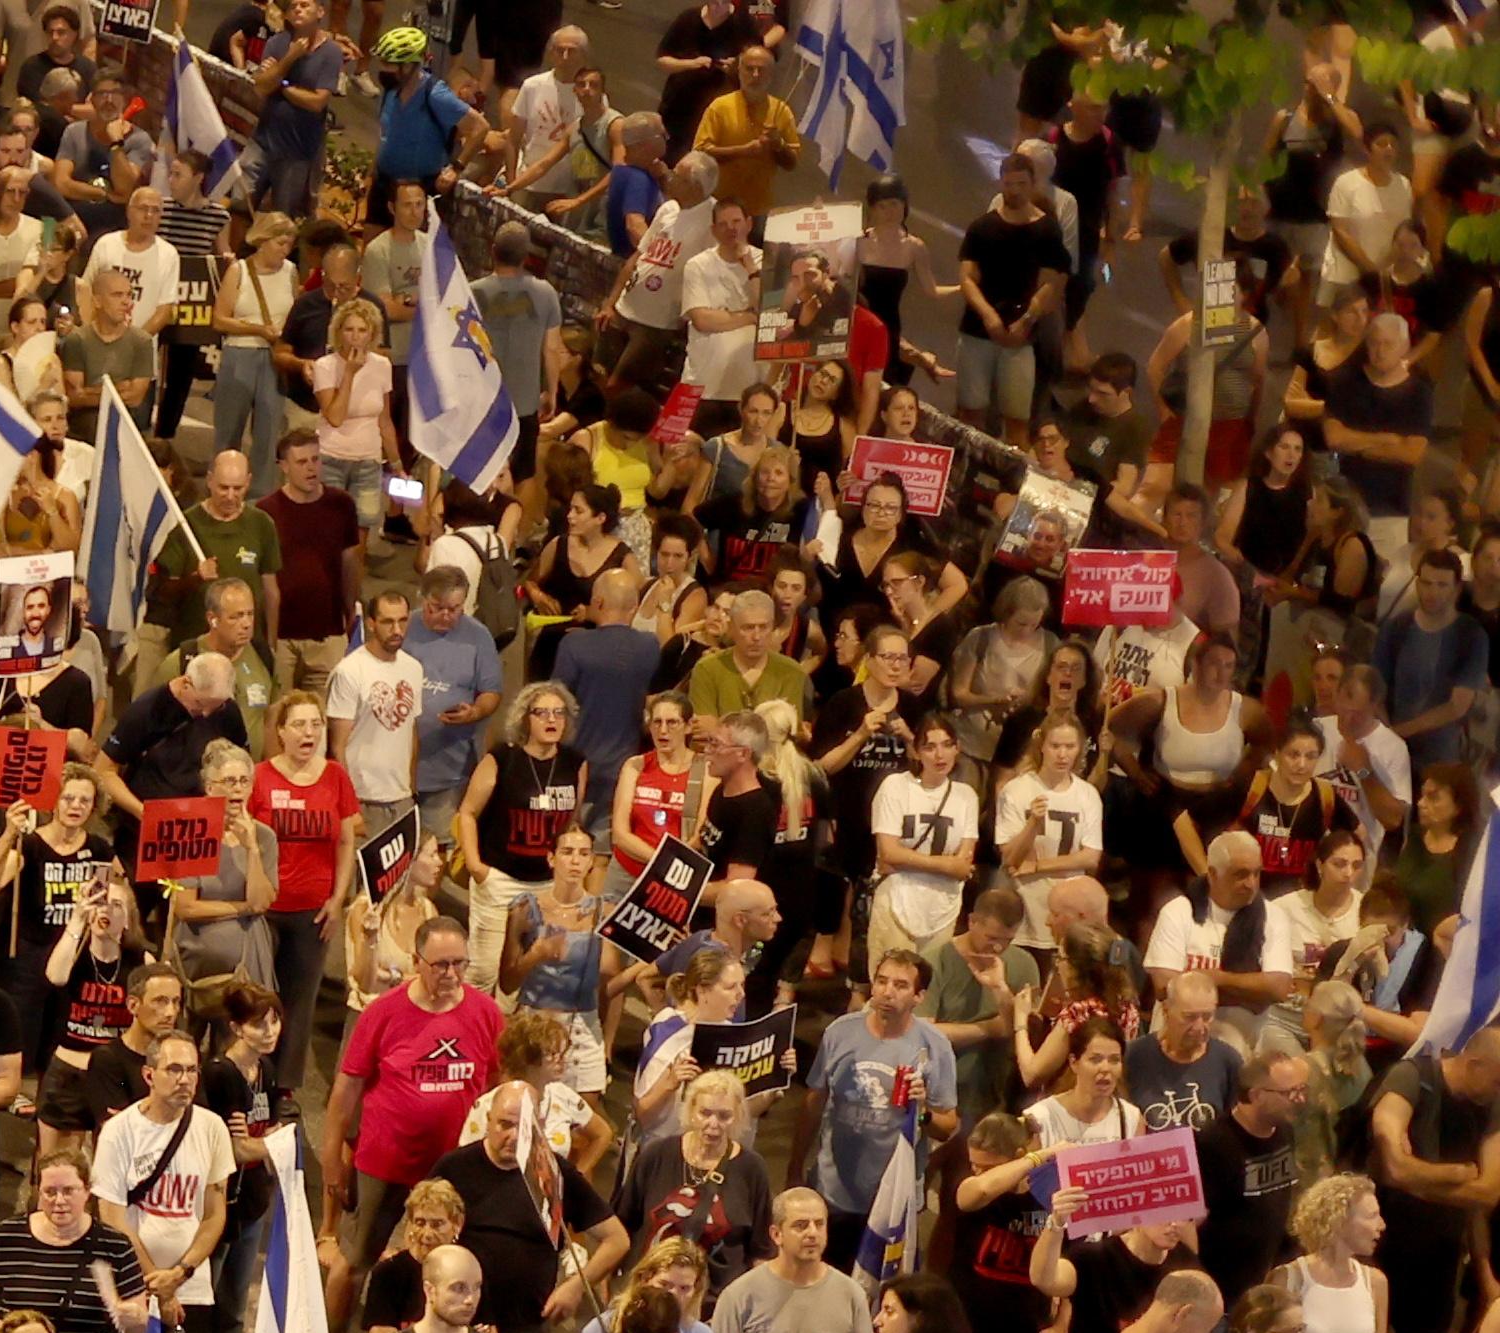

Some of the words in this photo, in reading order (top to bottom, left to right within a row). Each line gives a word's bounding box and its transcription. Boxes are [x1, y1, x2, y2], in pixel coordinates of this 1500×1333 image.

[1146, 565, 1172, 587] קול
[1118, 587, 1166, 607] זועק
[156, 817, 208, 842] כולנו
[141, 837, 218, 863] חטופים
[714, 1034, 776, 1066] עסקה
[1075, 1157, 1156, 1186] שהפקיר
[1159, 1152, 1182, 1172] מי
[1255, 1156, 1291, 1180] UFC
[1153, 1181, 1192, 1202] חייב
